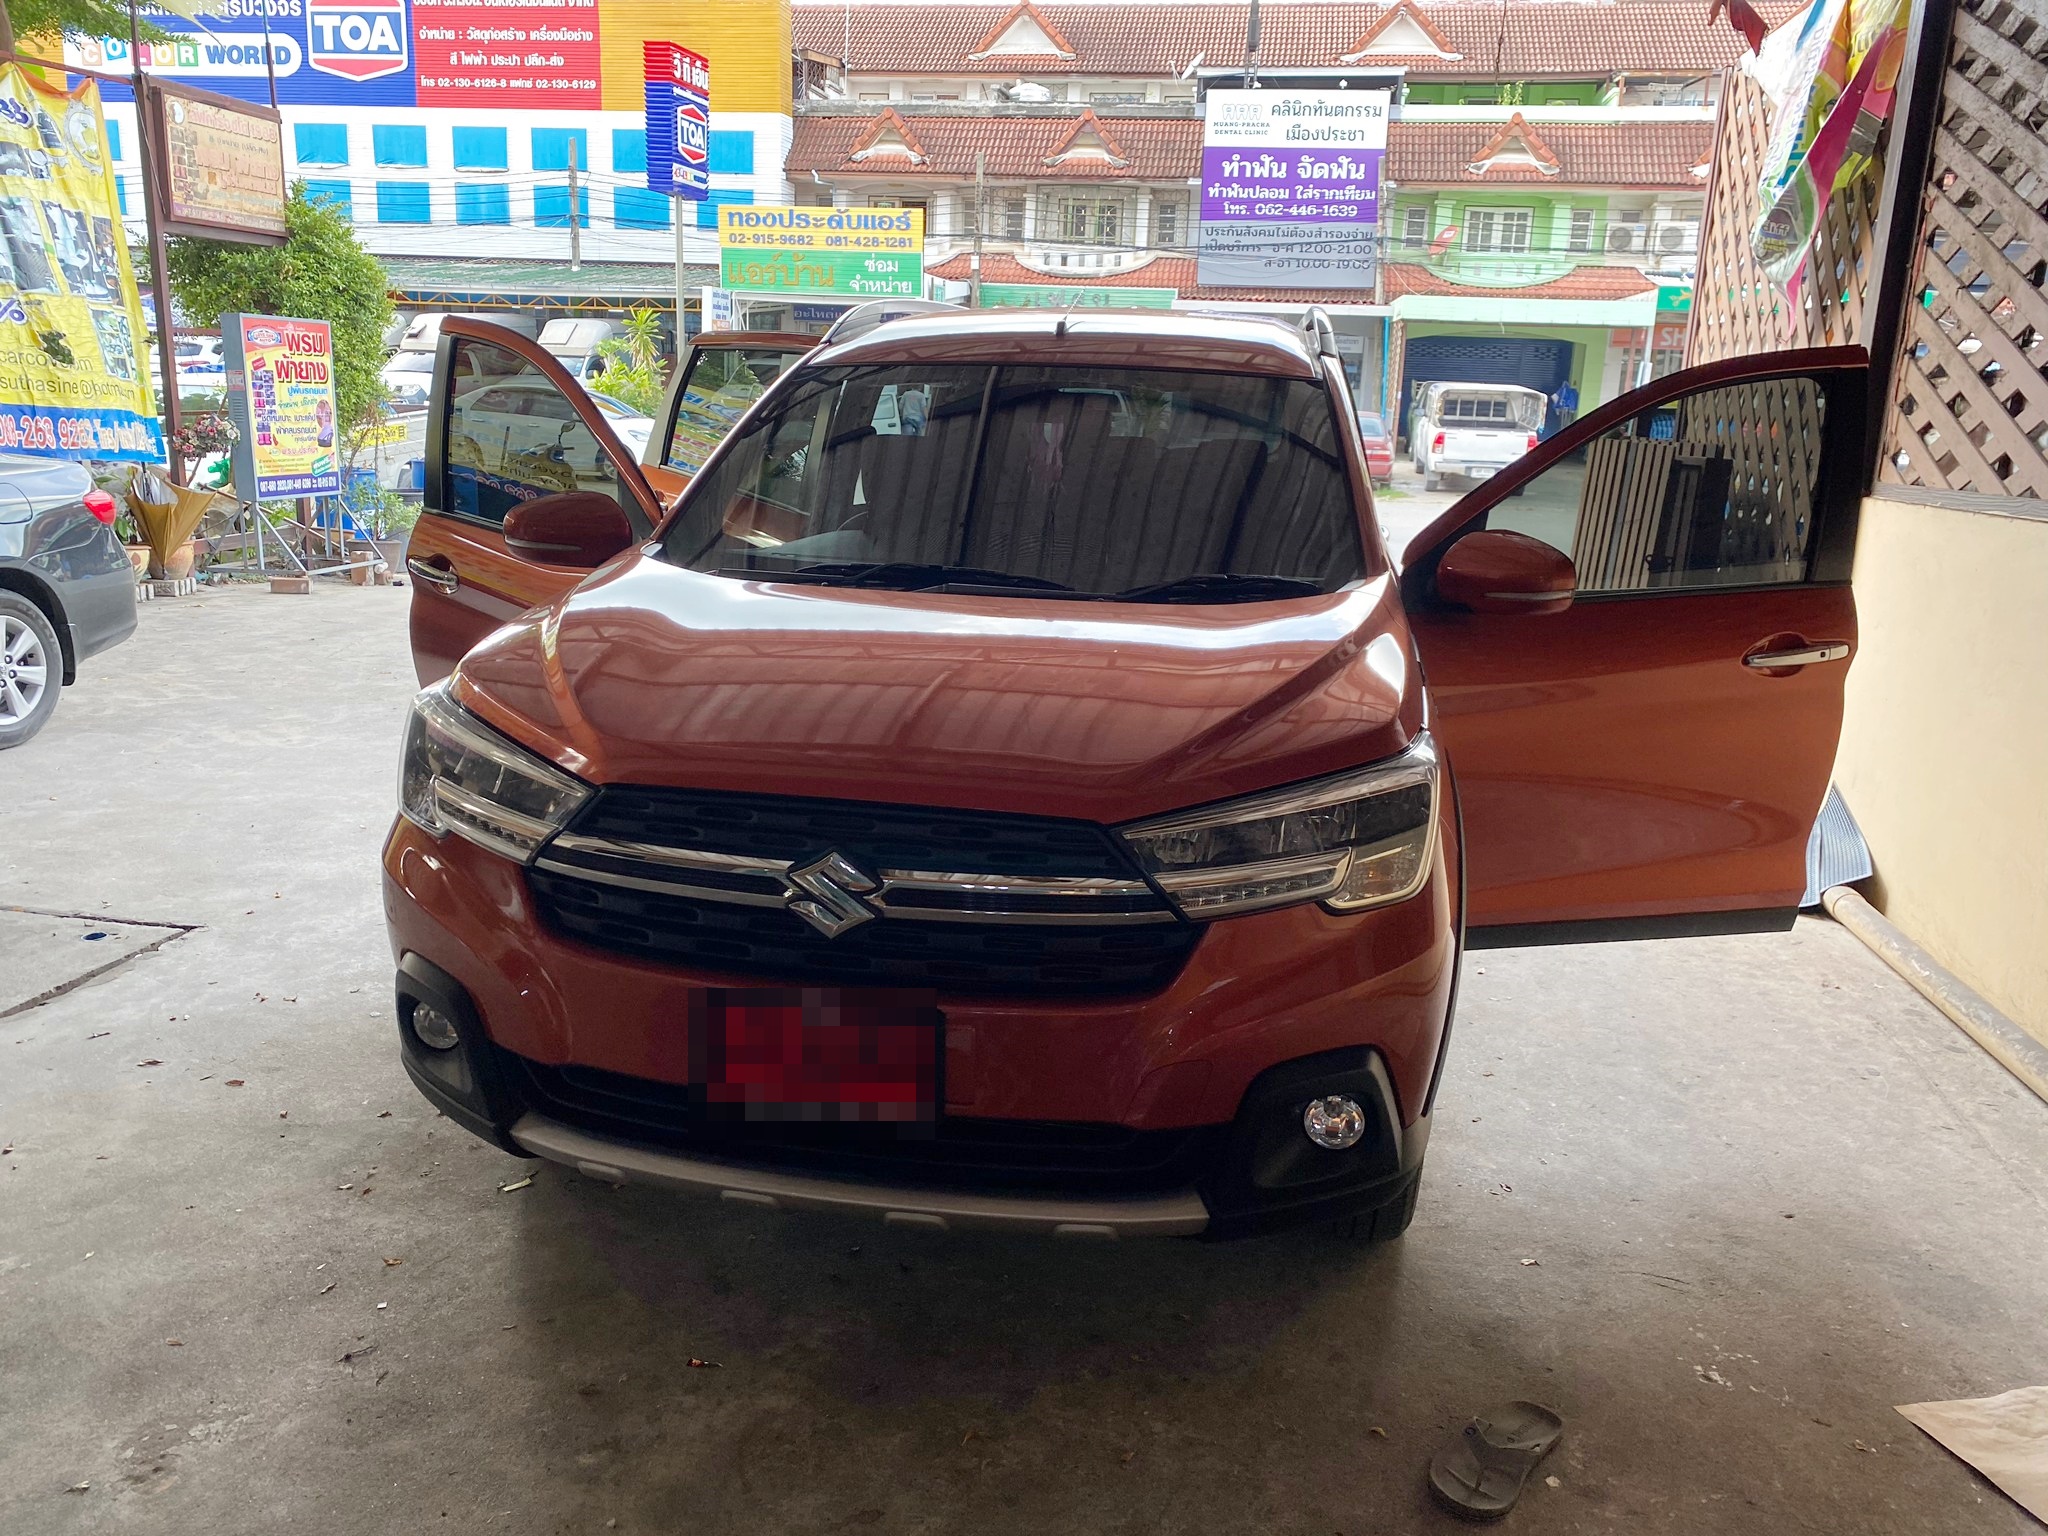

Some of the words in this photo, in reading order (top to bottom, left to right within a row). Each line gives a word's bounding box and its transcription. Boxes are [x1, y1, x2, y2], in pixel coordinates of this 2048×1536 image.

[313, 15, 400, 52] TOA
[419, 25, 456, 41] จำหน่าย
[466, 26, 526, 44] วัสดุก่อสร้าง
[529, 24, 594, 42] เครื่องมือช่าง
[205, 44, 291, 65] WORLD
[449, 51, 458, 66] สี
[461, 49, 488, 66] ไฟฟ้า
[491, 53, 521, 67] ประปา
[524, 52, 565, 67] ปลีก-ส่ง
[437, 77, 507, 88] 02-130-6126-8
[535, 78, 597, 89] 02-130-6129
[1271, 99, 1382, 118] คลินิกทันตกรรม
[681, 120, 705, 150] TOA
[1286, 124, 1365, 142] เมืองประชา
[1221, 153, 1287, 179] ทำฟัน
[1296, 155, 1366, 180] จัดฟัน
[1208, 182, 1290, 199] ทำฟันปลอม
[1295, 184, 1377, 201] ใส่รากเทียม
[727, 208, 912, 231] ทองประดับแอร์
[1223, 202, 1250, 215] โทร.
[1254, 203, 1358, 218] 062-446-1639
[728, 233, 814, 246] 02-915-9682
[825, 235, 913, 248] 081-428-1281
[727, 252, 835, 288] แอร์บ้าน
[864, 253, 899, 273] ซ่อม
[849, 274, 913, 294] จำหน่าย
[285, 331, 325, 356] พรม
[275, 354, 328, 384] ผ้ายาง
